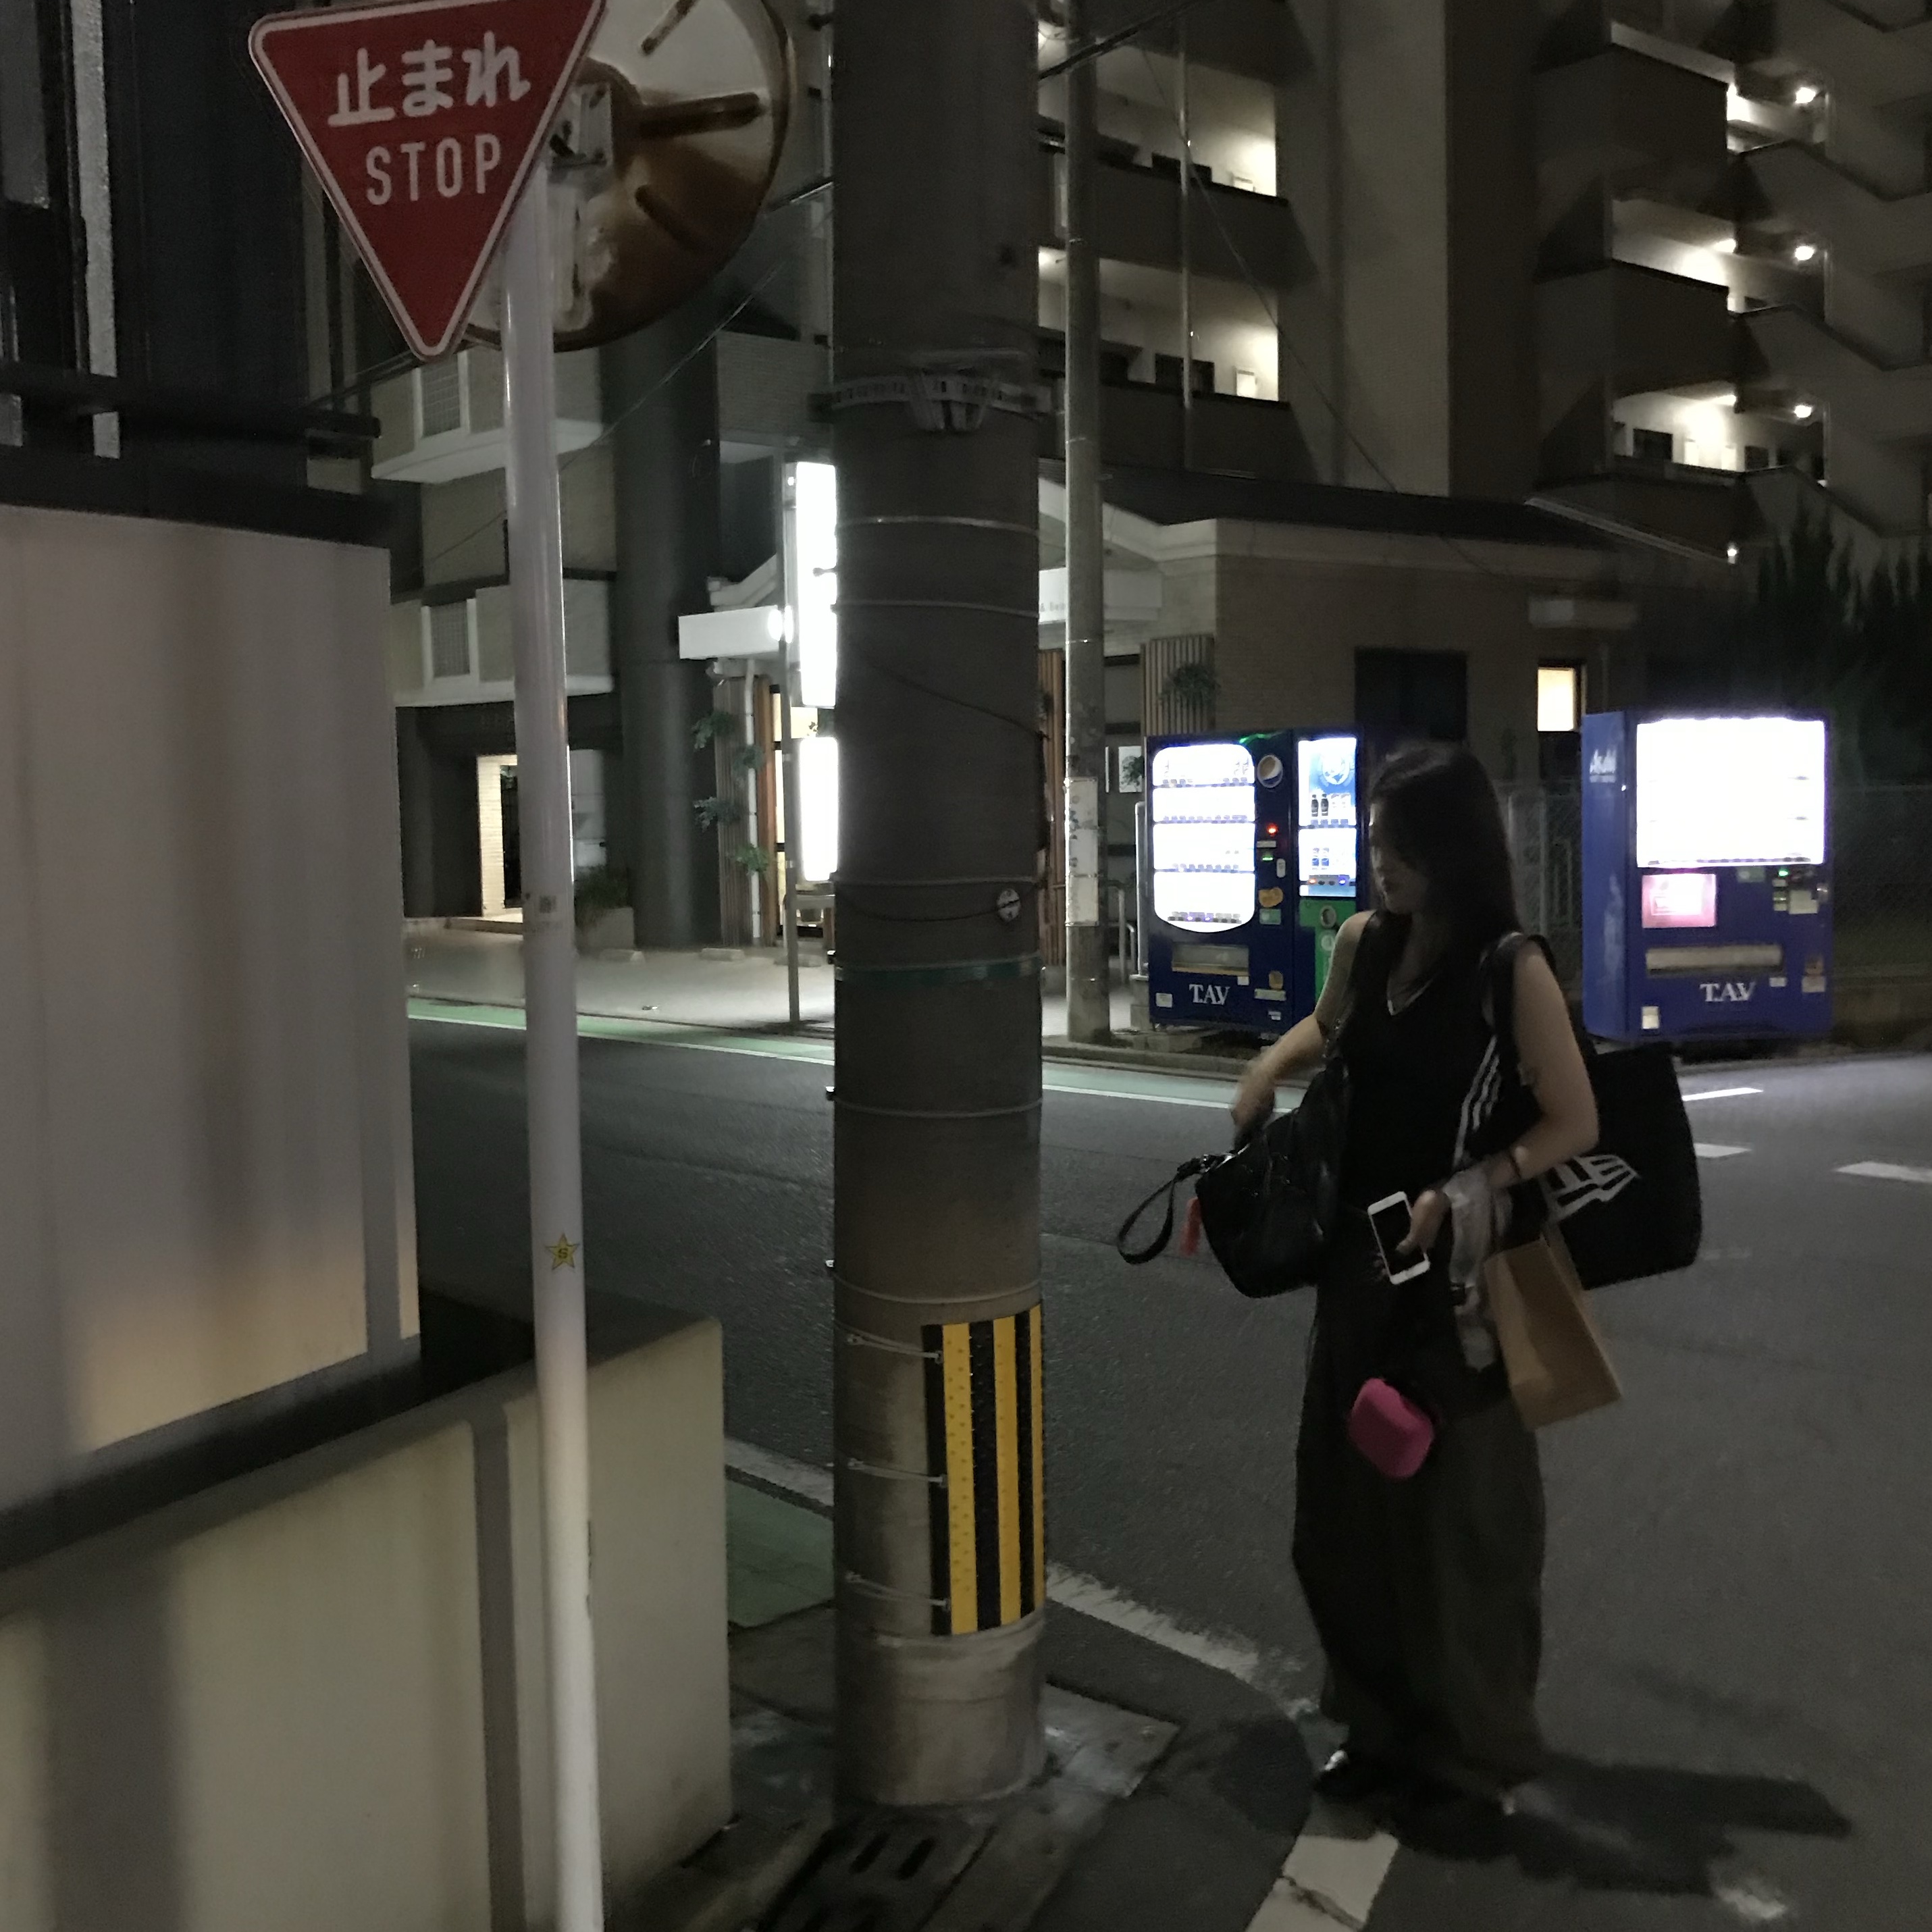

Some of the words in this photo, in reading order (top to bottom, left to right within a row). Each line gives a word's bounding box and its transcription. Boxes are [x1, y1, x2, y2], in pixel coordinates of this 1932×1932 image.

[328, 30, 531, 128] 止まれ
[365, 134, 501, 205] STOP
[557, 1247, 569, 1259] S
